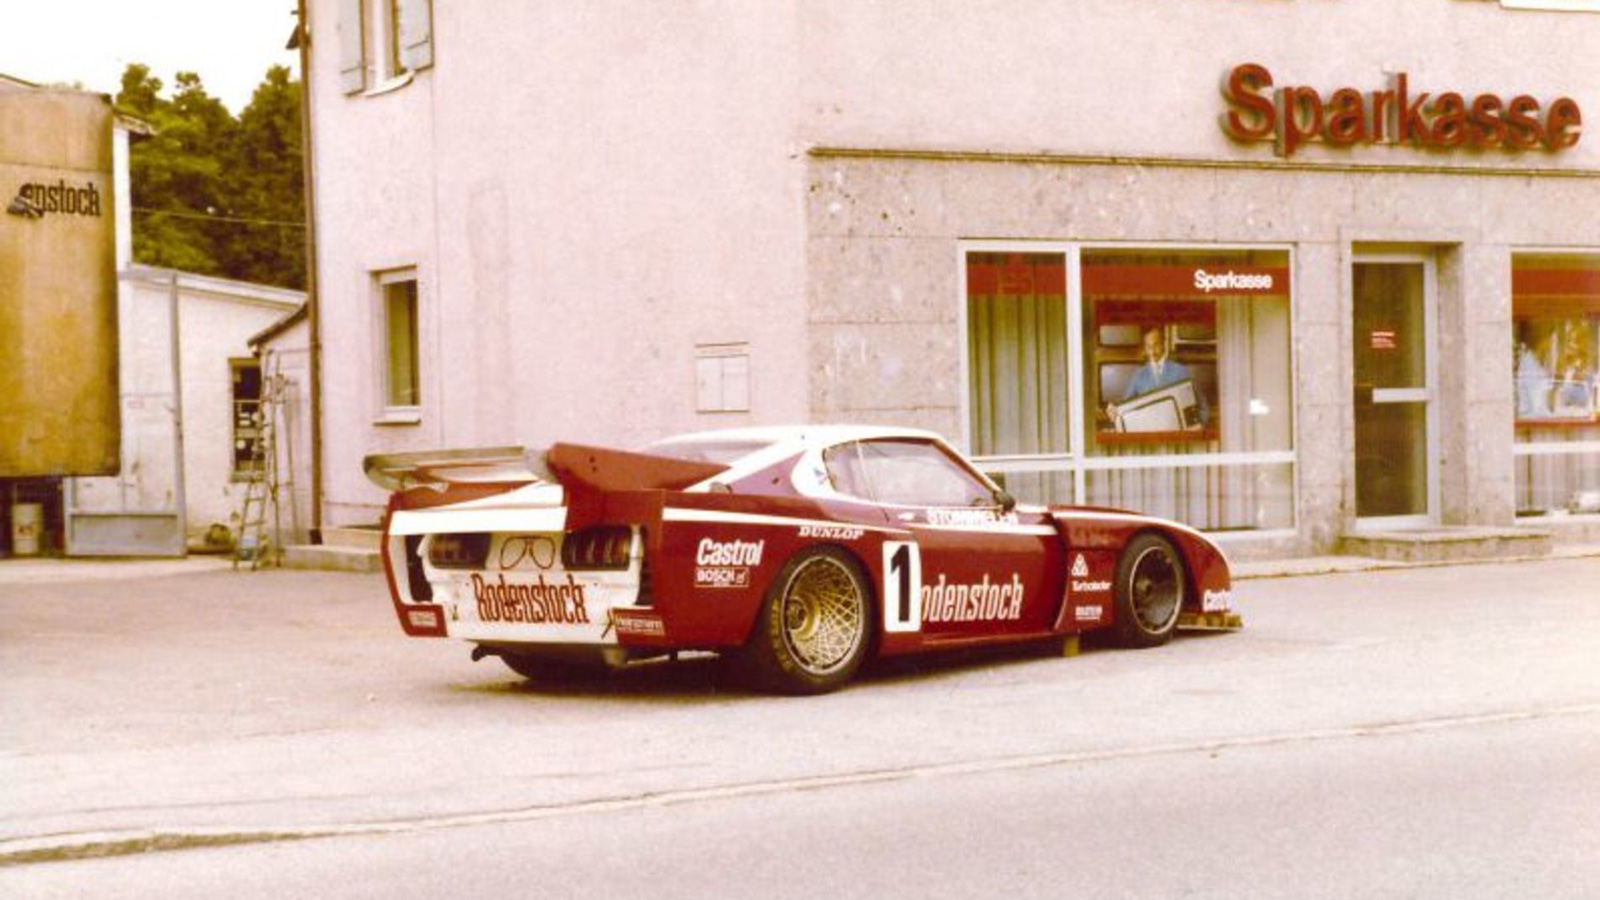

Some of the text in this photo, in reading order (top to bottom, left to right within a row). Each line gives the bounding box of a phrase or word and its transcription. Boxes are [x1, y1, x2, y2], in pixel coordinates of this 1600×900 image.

[1221, 63, 1582, 158] Sparkasse
[1193, 269, 1274, 293] Sparkasse
[798, 526, 864, 539] DUNLOP
[697, 537, 765, 566] Castrol
[697, 570, 735, 582] BOSCH
[891, 544, 911, 622] 1
[471, 573, 590, 624] Rodenstock
